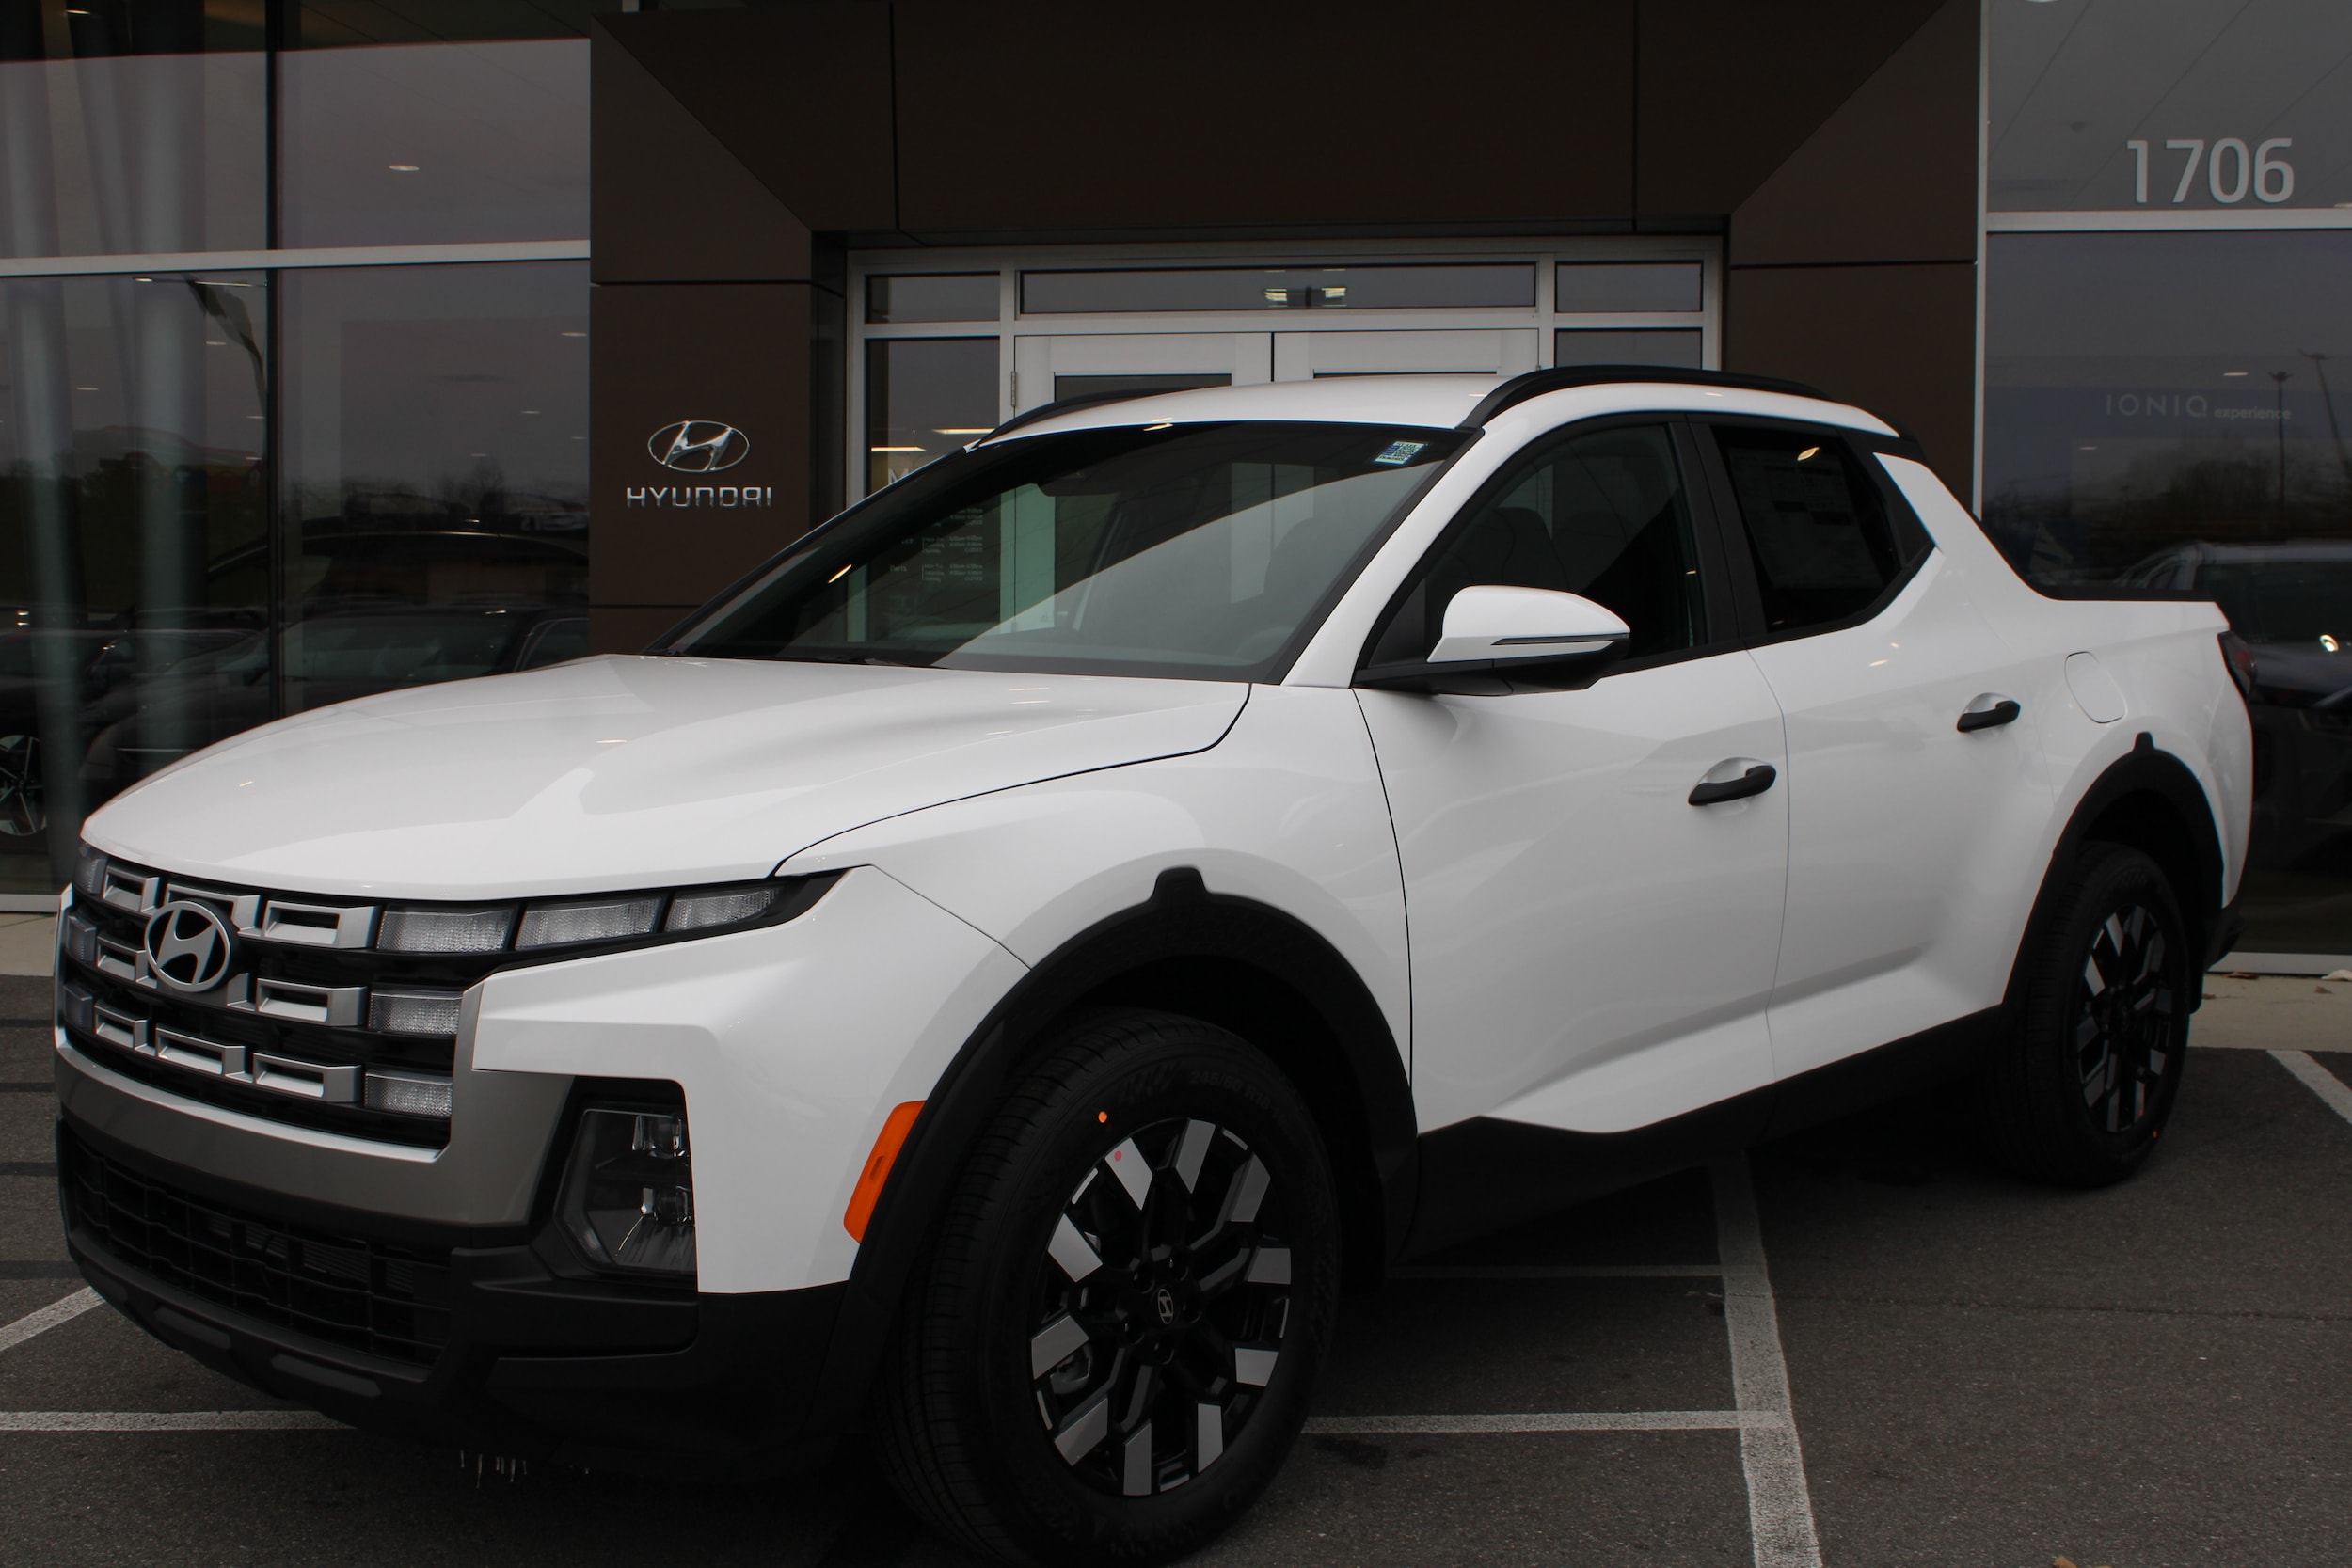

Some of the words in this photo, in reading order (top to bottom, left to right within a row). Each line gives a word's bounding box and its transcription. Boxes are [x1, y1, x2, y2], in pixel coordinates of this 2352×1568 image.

[2126, 137, 2295, 204] 1706
[2106, 393, 2209, 418] IONIQ
[2214, 406, 2292, 420] experience
[626, 486, 772, 509] HYUNDAI
